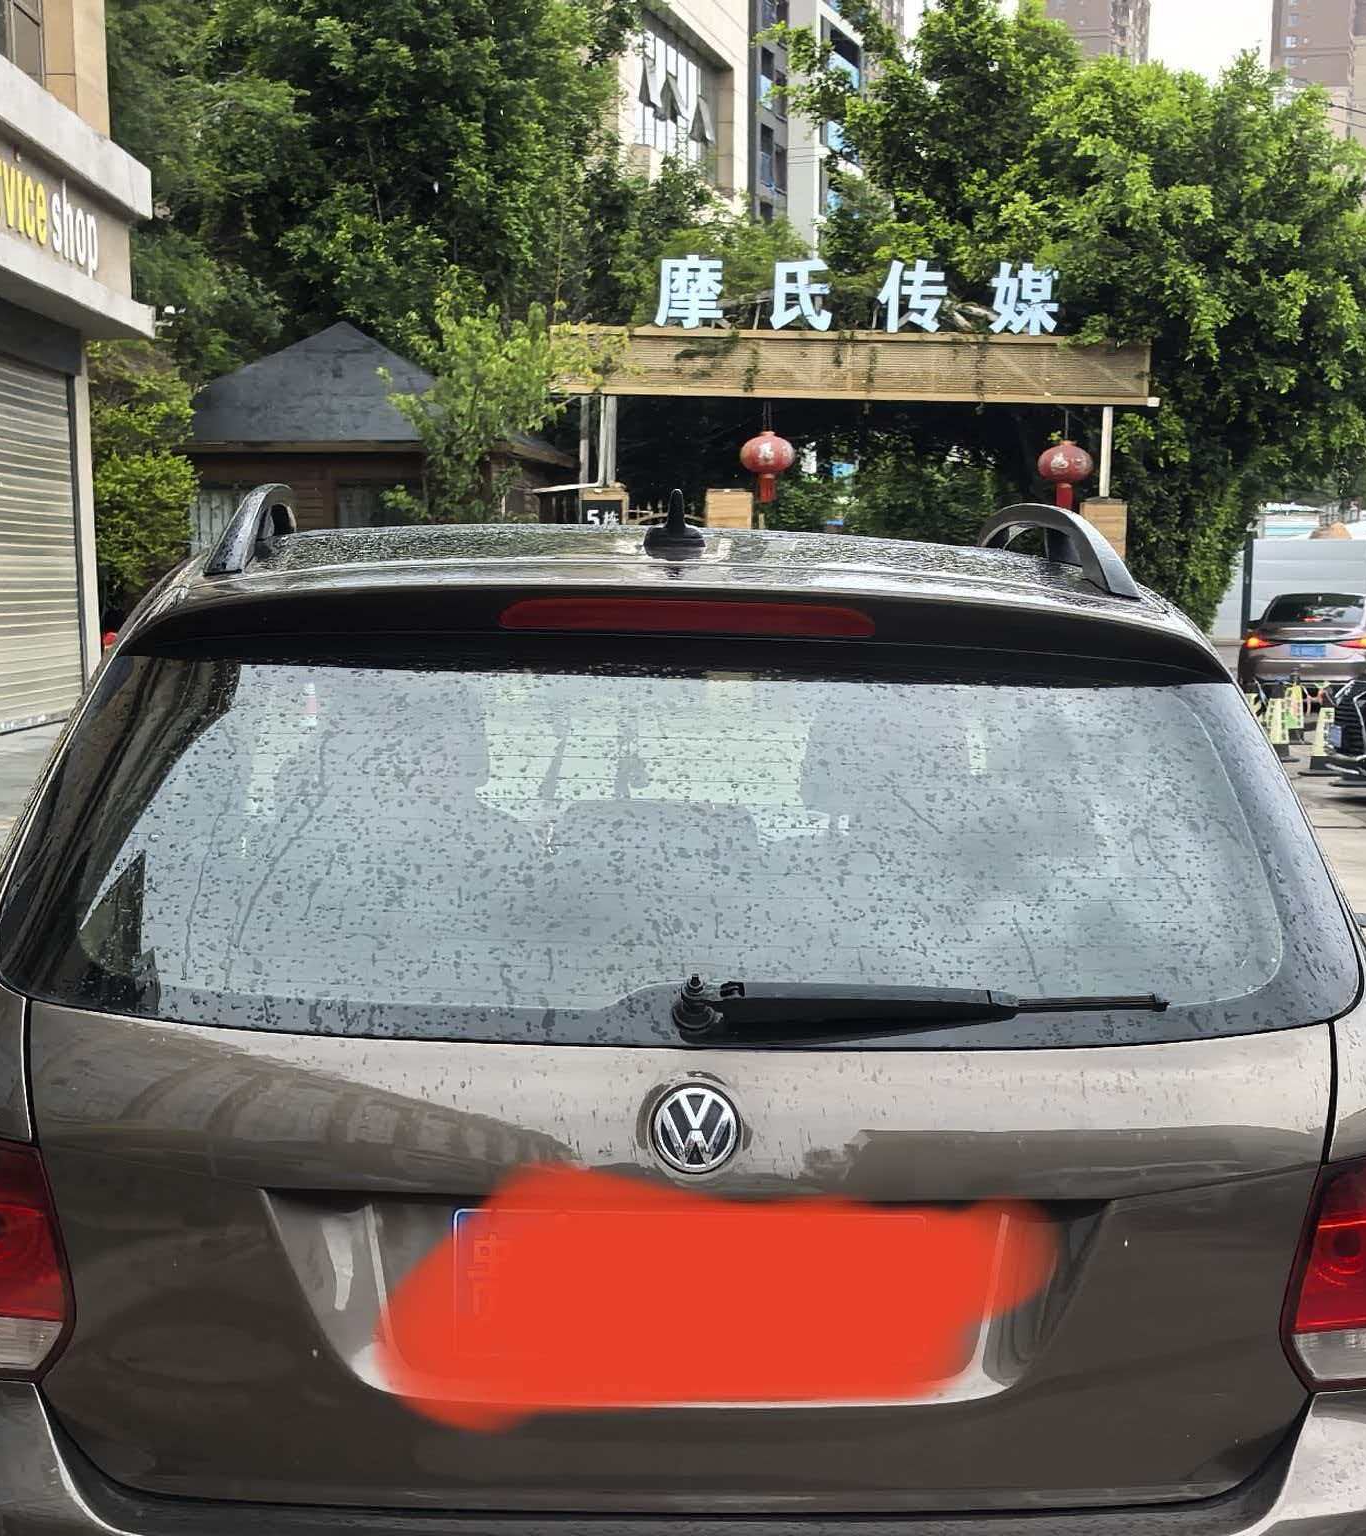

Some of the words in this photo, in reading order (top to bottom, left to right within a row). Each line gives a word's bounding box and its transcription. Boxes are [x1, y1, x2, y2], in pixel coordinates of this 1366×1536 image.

[51, 179, 99, 279] shop
[654, 254, 1060, 336] 摩氏传媒
